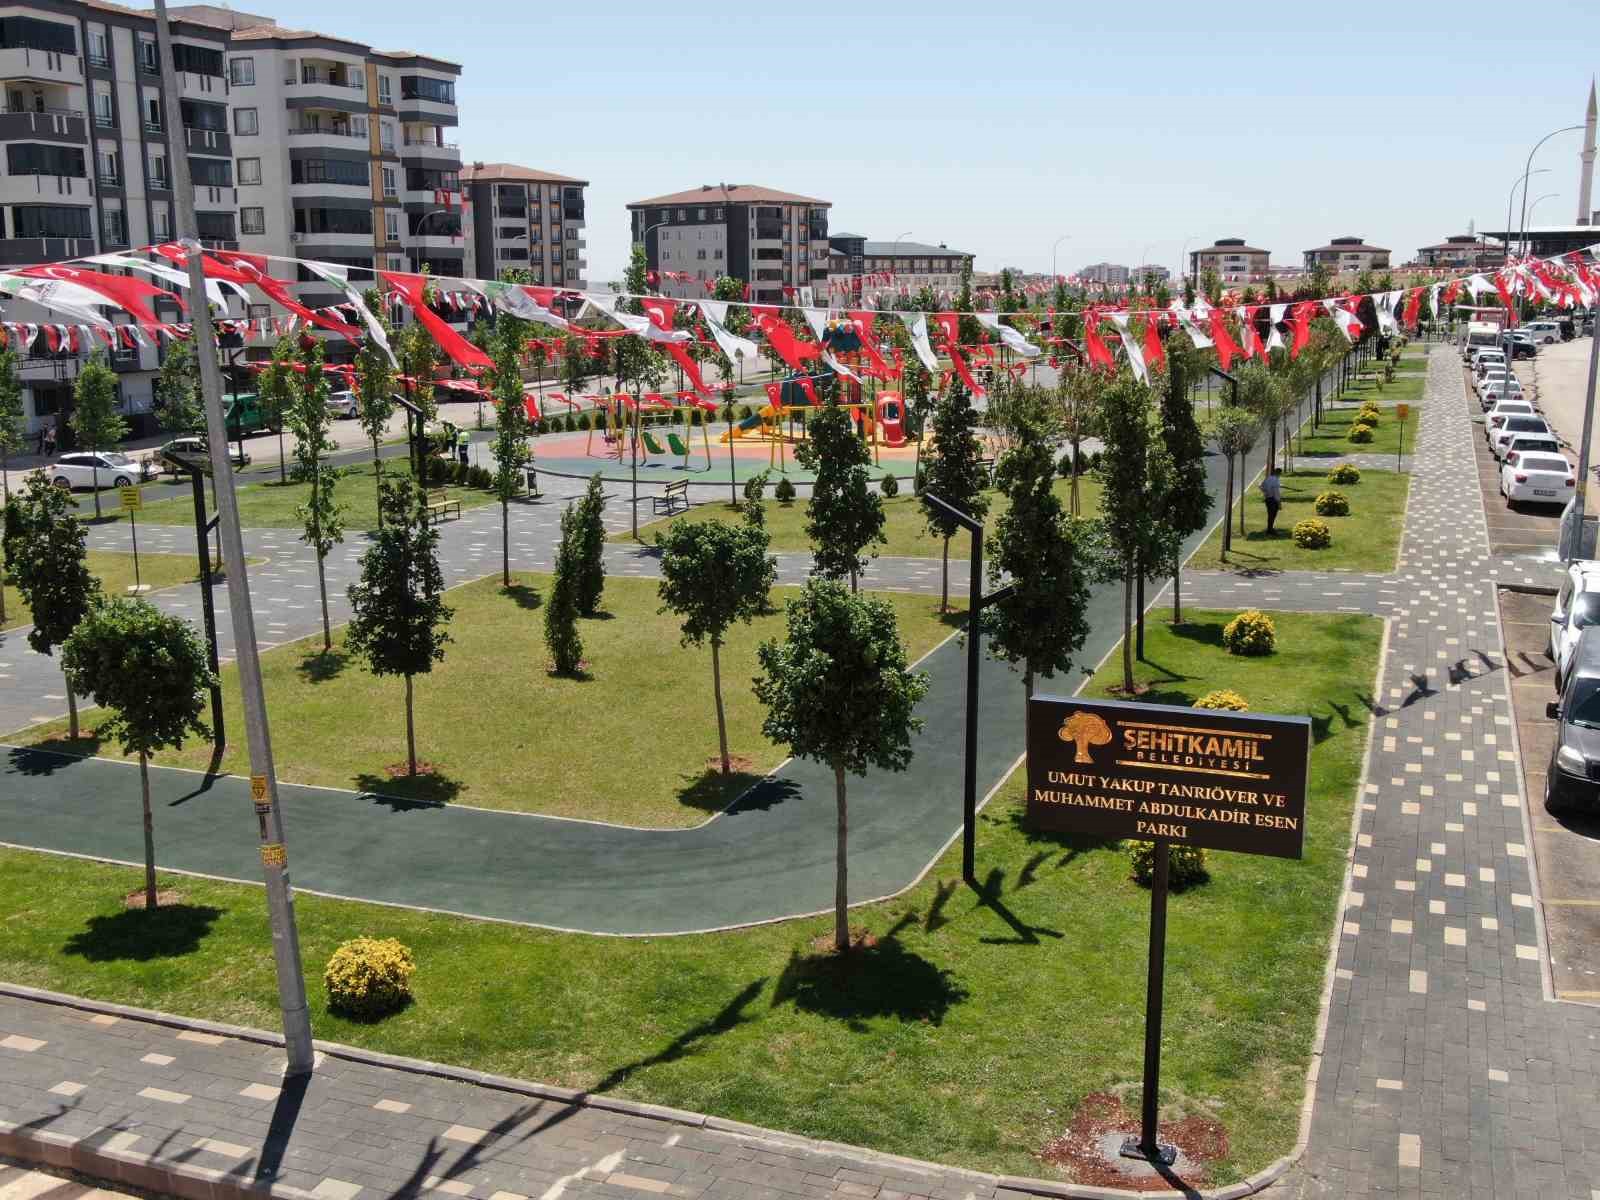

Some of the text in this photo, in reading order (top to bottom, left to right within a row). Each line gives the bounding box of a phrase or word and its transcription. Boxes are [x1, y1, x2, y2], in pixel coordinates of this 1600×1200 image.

[1136, 751, 1249, 770] BELEDİYESİ
[1048, 771, 1287, 808] UMUT YAKUP TANRIÖVER VE
[1034, 789, 1298, 830] MUHAMMET ABDULKADİR ESEN
[1136, 821, 1188, 838] PARKI
